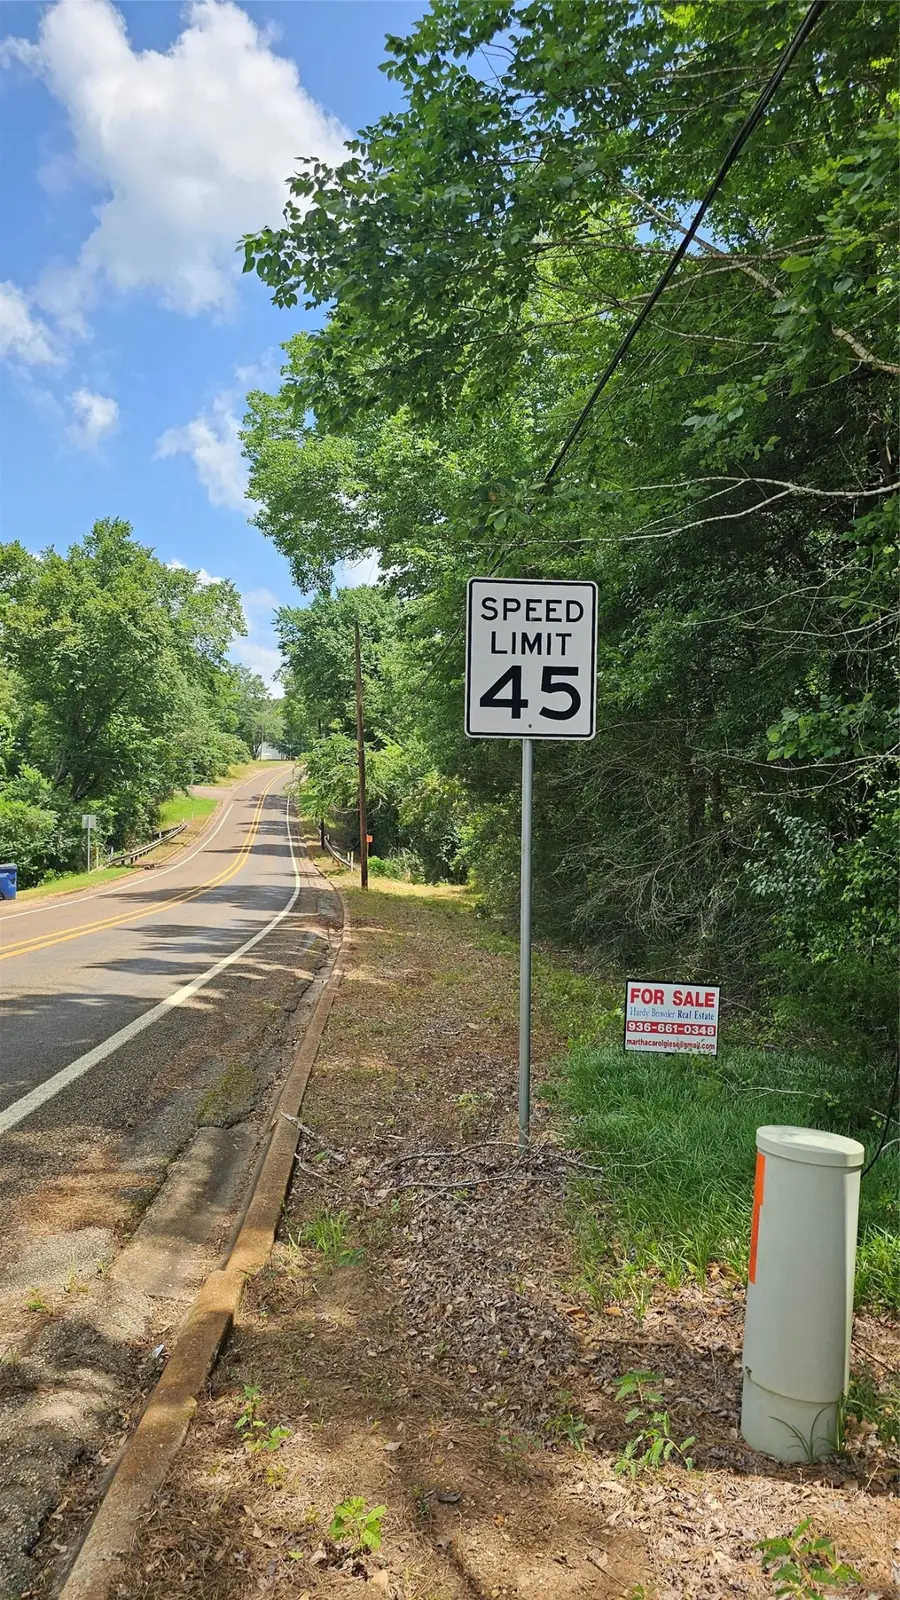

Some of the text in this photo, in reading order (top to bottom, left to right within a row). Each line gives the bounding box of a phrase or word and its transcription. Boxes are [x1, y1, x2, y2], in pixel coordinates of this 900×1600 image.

[480, 597, 584, 623] SPEED
[491, 631, 572, 656] LIMIT
[479, 665, 581, 721] 45
[630, 988, 715, 1008] FOR SALE
[630, 1006, 714, 1020] Hardy Browder Real Estate
[628, 1022, 714, 1035] 936-661-0348
